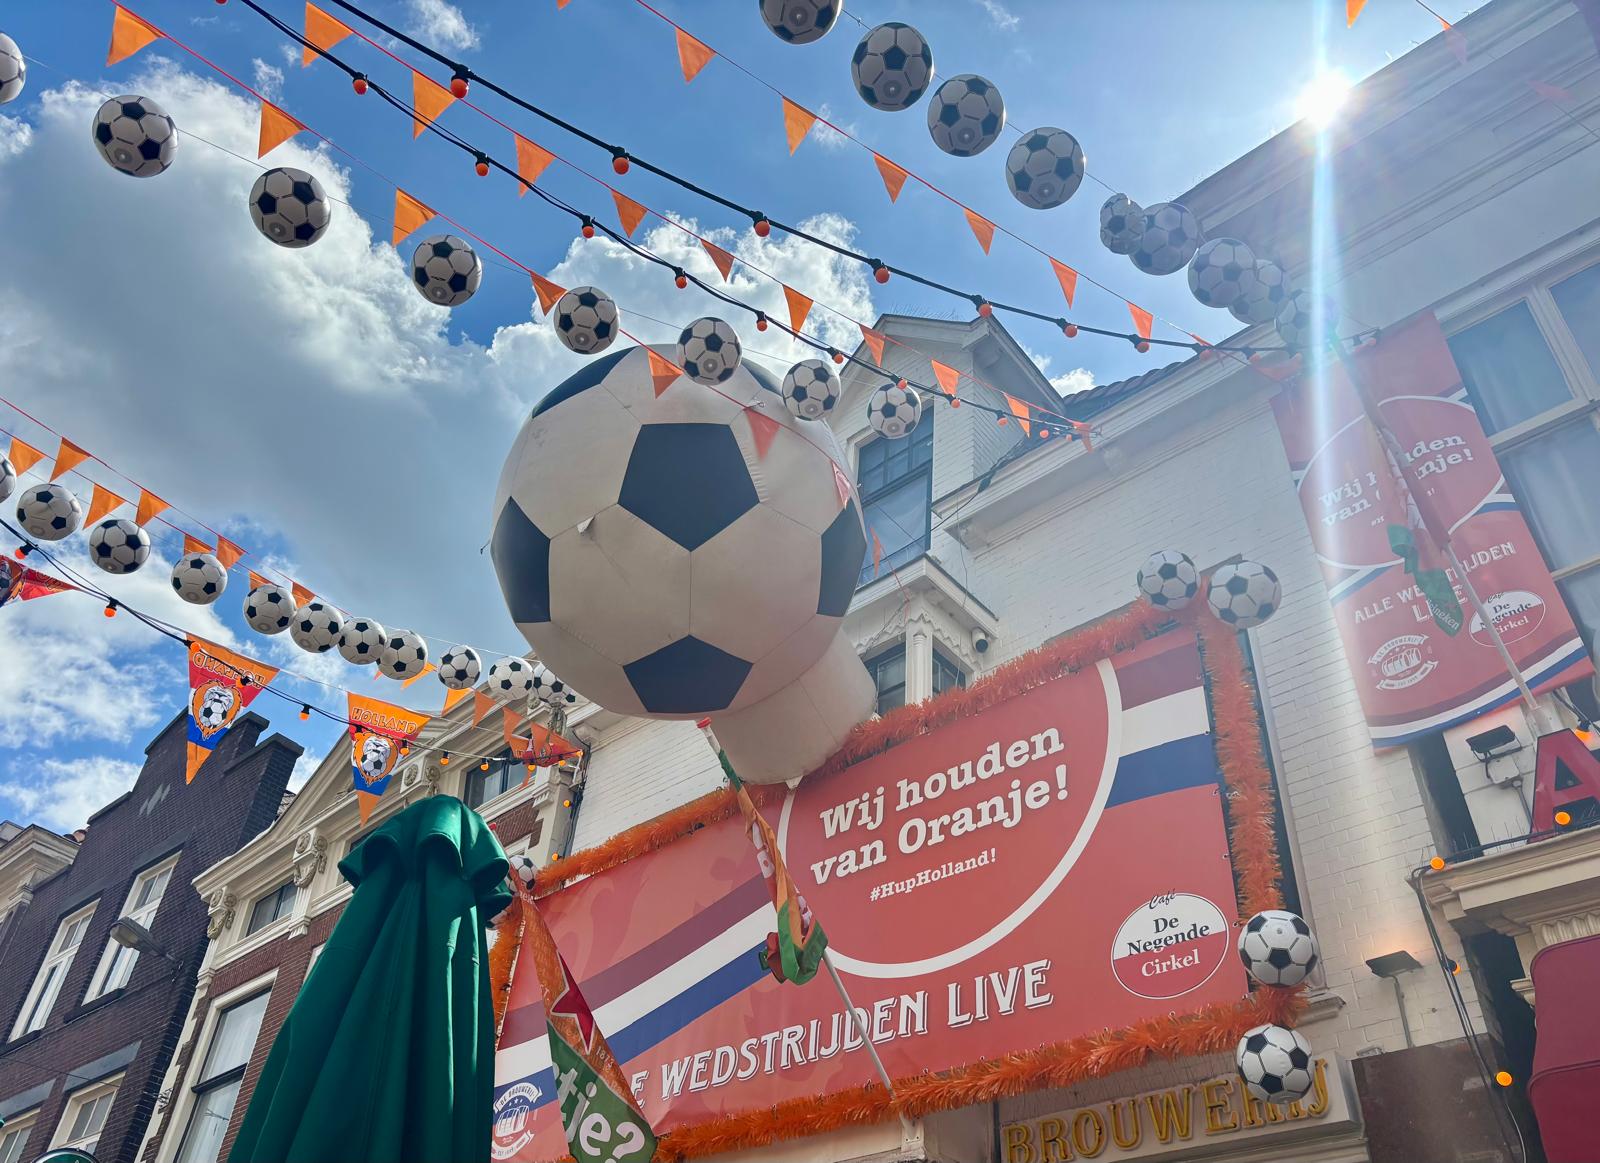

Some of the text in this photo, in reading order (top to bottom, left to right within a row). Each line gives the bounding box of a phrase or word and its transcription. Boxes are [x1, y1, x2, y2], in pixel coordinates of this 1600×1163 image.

[1319, 478, 1363, 508] Wij
[1321, 498, 1373, 528] van
[1354, 596, 1394, 625] ALLE
[1493, 602, 1511, 614] De
[1496, 615, 1530, 634] irkel
[351, 707, 417, 735] HOLLAND
[819, 727, 1065, 839] Wij houden
[810, 764, 1069, 885] van Oranje!
[869, 847, 997, 902] #HupHolland!
[1148, 888, 1177, 910] Café
[1127, 924, 1210, 956] Negende
[1153, 917, 1180, 934] De
[1141, 949, 1201, 977] Cirkel
[660, 990, 929, 1101] WEDSTRIJDEN
[947, 959, 1055, 1029] LIVE
